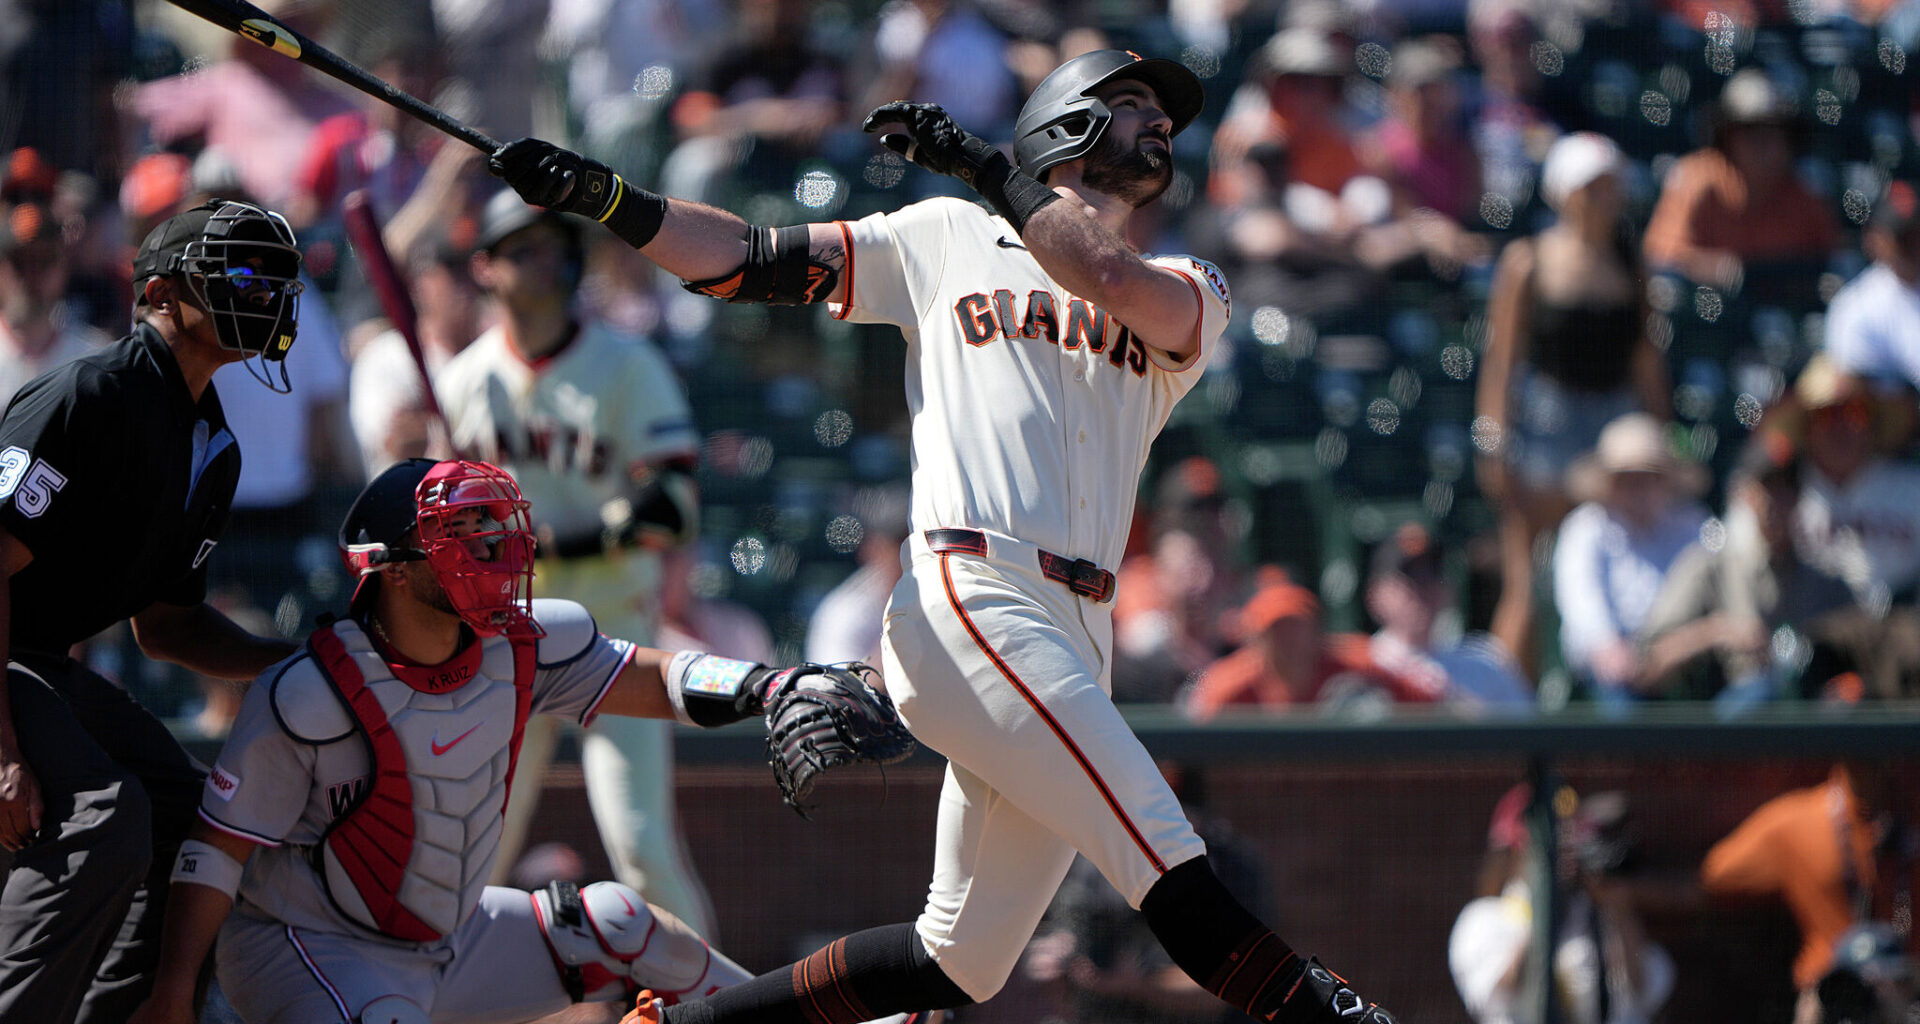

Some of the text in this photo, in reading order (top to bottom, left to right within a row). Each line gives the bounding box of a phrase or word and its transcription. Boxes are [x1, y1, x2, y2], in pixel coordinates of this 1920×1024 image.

[0, 445, 68, 518] 35
[428, 665, 472, 690] K RUIZ
[182, 859, 197, 872] 20
